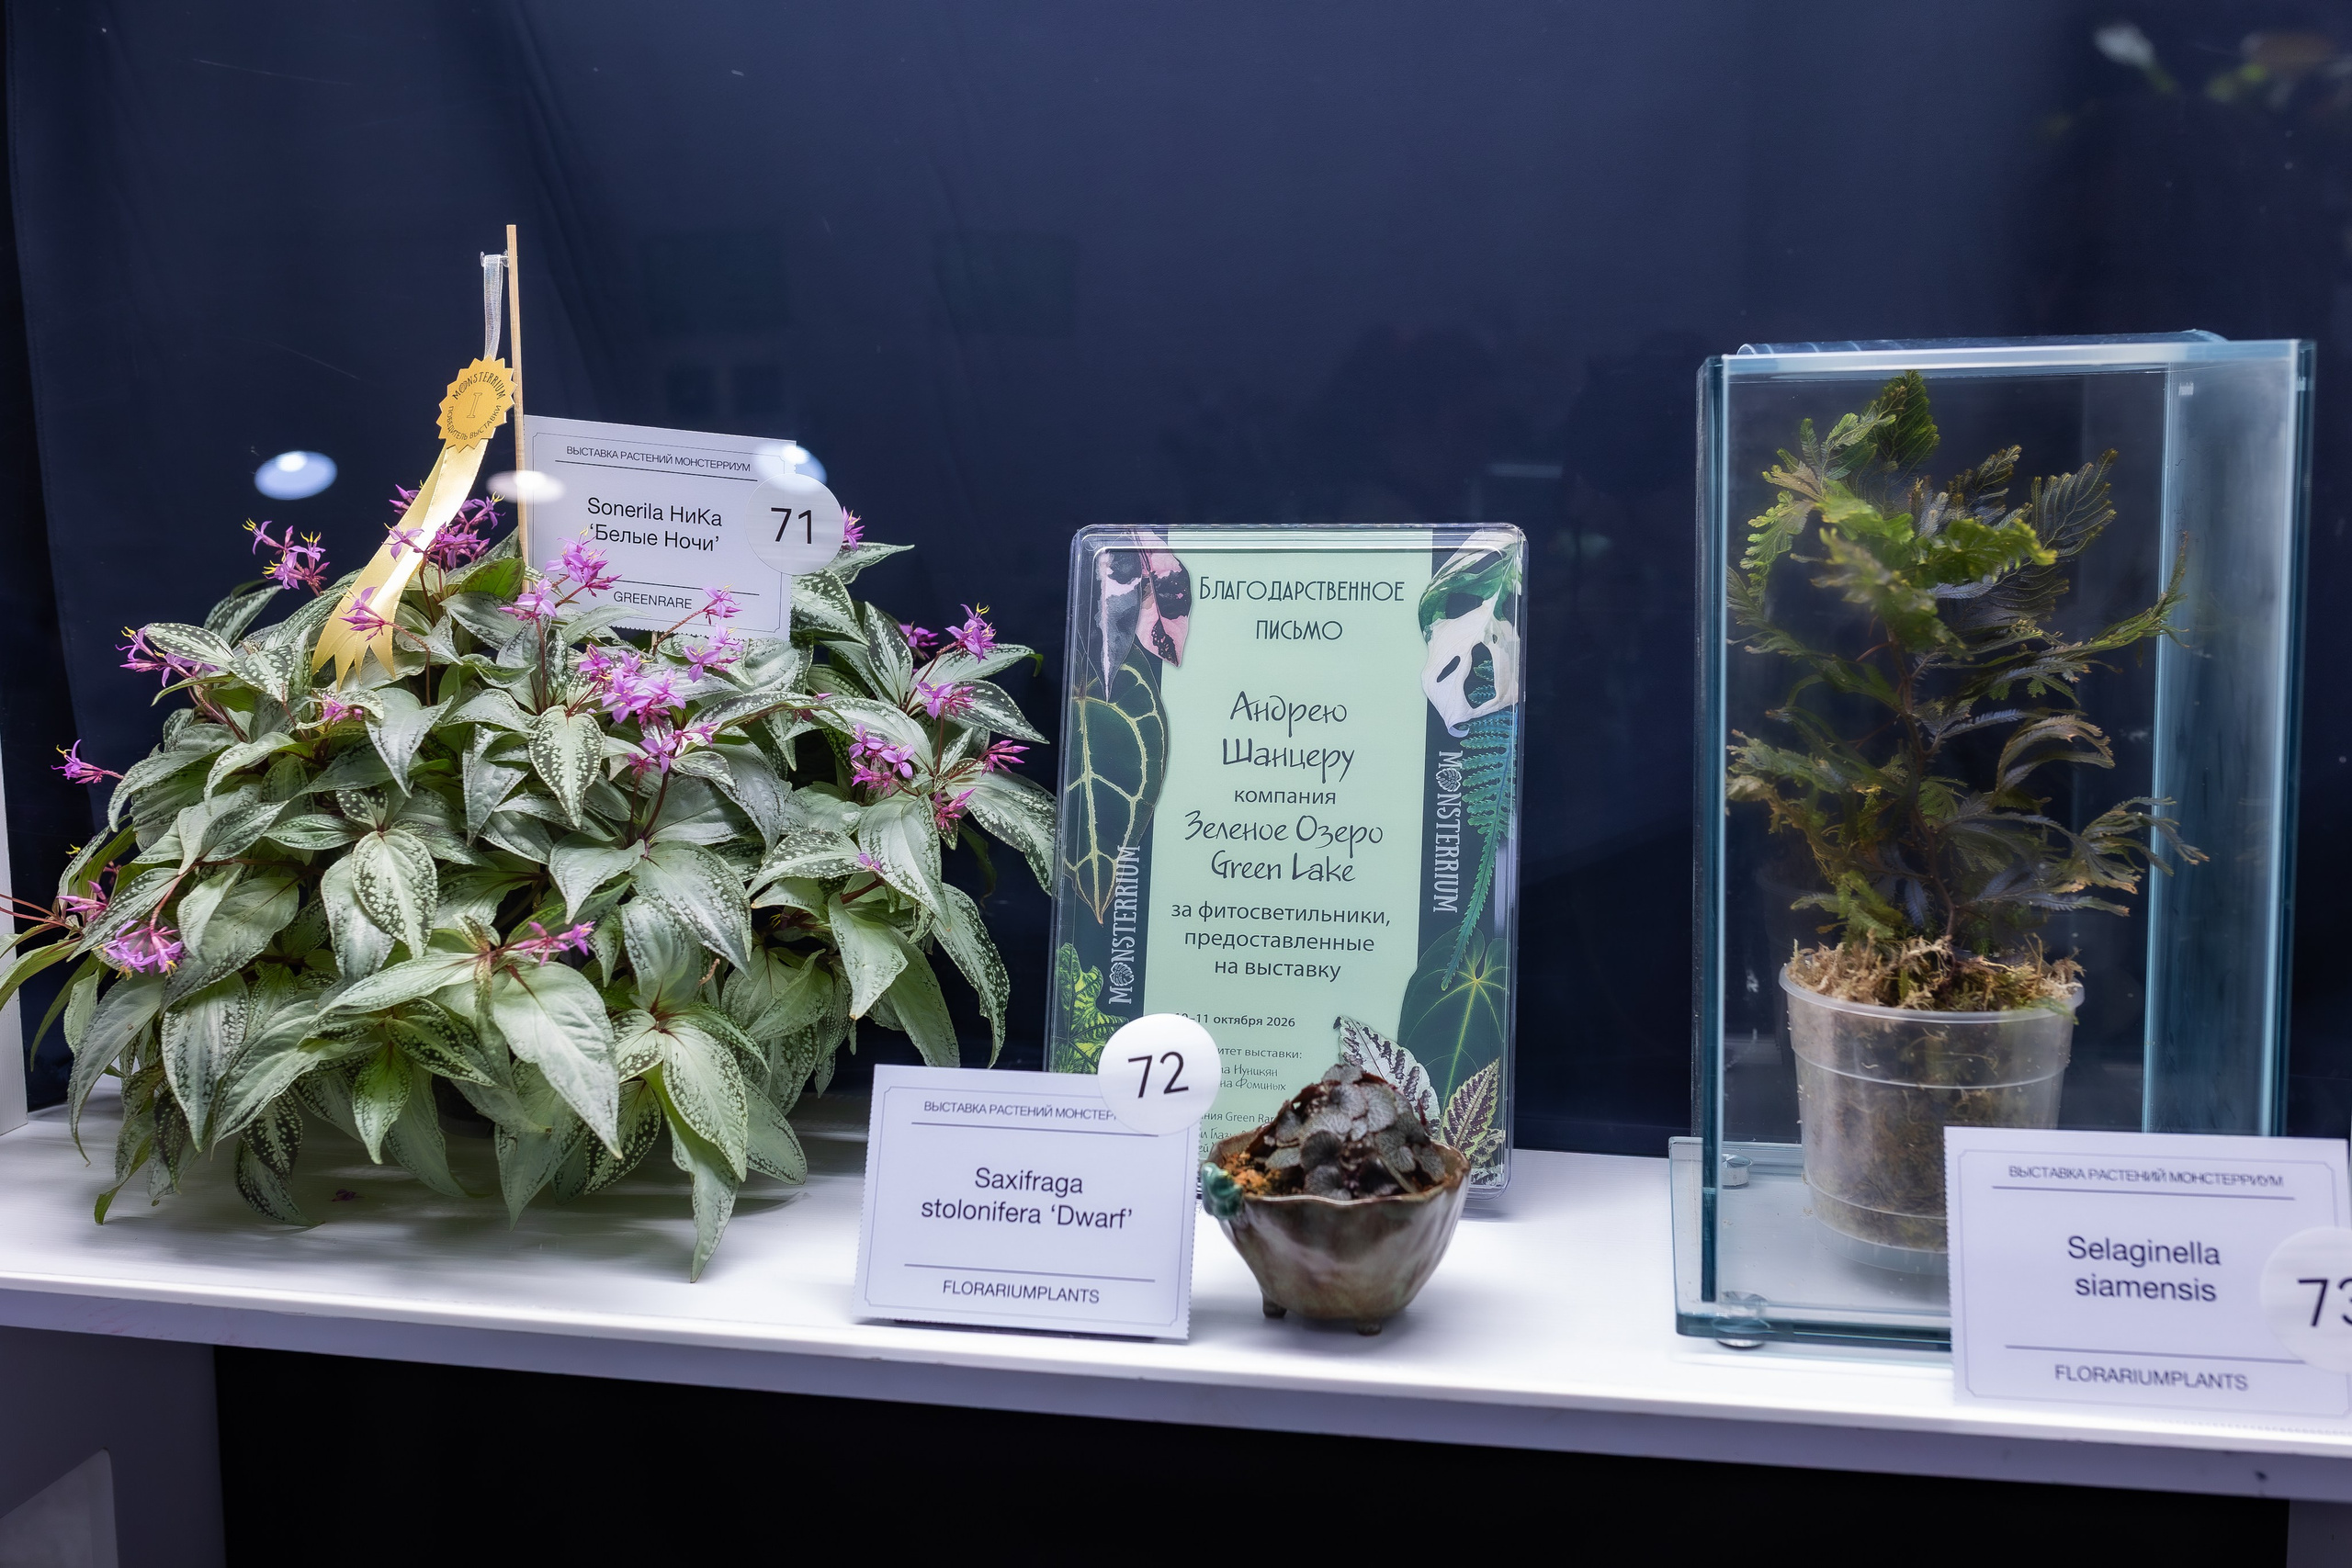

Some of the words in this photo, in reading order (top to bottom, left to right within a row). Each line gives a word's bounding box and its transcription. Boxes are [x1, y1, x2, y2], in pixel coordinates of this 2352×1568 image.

[452, 371, 506, 400] MONSTERRIUM
[446, 405, 469, 441] ПОБЕДИТЕЛЬ
[469, 404, 502, 439] ВЫСТАВКИ
[566, 446, 619, 459] ВЫСТАВКА
[620, 451, 673, 465] РАСТЕНИЙ
[675, 457, 752, 472] МОНСТЕРРИУМ
[587, 497, 664, 522] Sonerila
[670, 504, 723, 527] НиКа
[770, 507, 813, 545] 71
[613, 590, 693, 610] GREENRARE
[1229, 690, 1348, 739] Андрею
[1222, 738, 1355, 784] Шанцеру
[1234, 789, 1336, 805] компания
[1184, 809, 1289, 841] Зеленое
[1295, 815, 1384, 859] Озеро
[1432, 750, 1464, 913] MONSTERRIUM
[1211, 849, 1283, 881] Green
[1291, 852, 1356, 883] Lake
[1108, 844, 1140, 1005] MONSTERRIUM
[1170, 904, 1193, 918] за
[1198, 900, 1391, 927] фитосветильники,
[1184, 931, 1374, 952] предоставленные
[1215, 961, 1238, 975] на
[1245, 962, 1341, 983] выставку
[1213, 1015, 1263, 1028] октября
[1266, 1016, 1296, 1028] 2026
[1245, 1048, 1302, 1059] выставки:
[1127, 1051, 1190, 1099] 72
[1235, 1077, 1286, 1091] Фоминых
[923, 1100, 988, 1115] ВЫСТАВКА
[989, 1104, 1054, 1119] РАСТЕНИЙ
[1056, 1108, 1116, 1122] МОНСТЕР
[1225, 1111, 1256, 1122] Green
[1258, 1113, 1275, 1124] Rar
[975, 1167, 1083, 1198] Saxifraga
[2008, 1165, 2086, 1180] ВЫСТАВКА
[2088, 1168, 2166, 1184] РАСТЕНИЙ
[2168, 1170, 2285, 1188] МОНСТЕРРИУМ
[921, 1198, 1042, 1224] stolonifera
[2067, 1235, 2222, 1269] Selaginella
[943, 1280, 1101, 1304] FLORARIUMPLANTS
[2075, 1272, 2219, 1303] siamensis
[2054, 1364, 2249, 1392] FLORARIUMPLANTS
